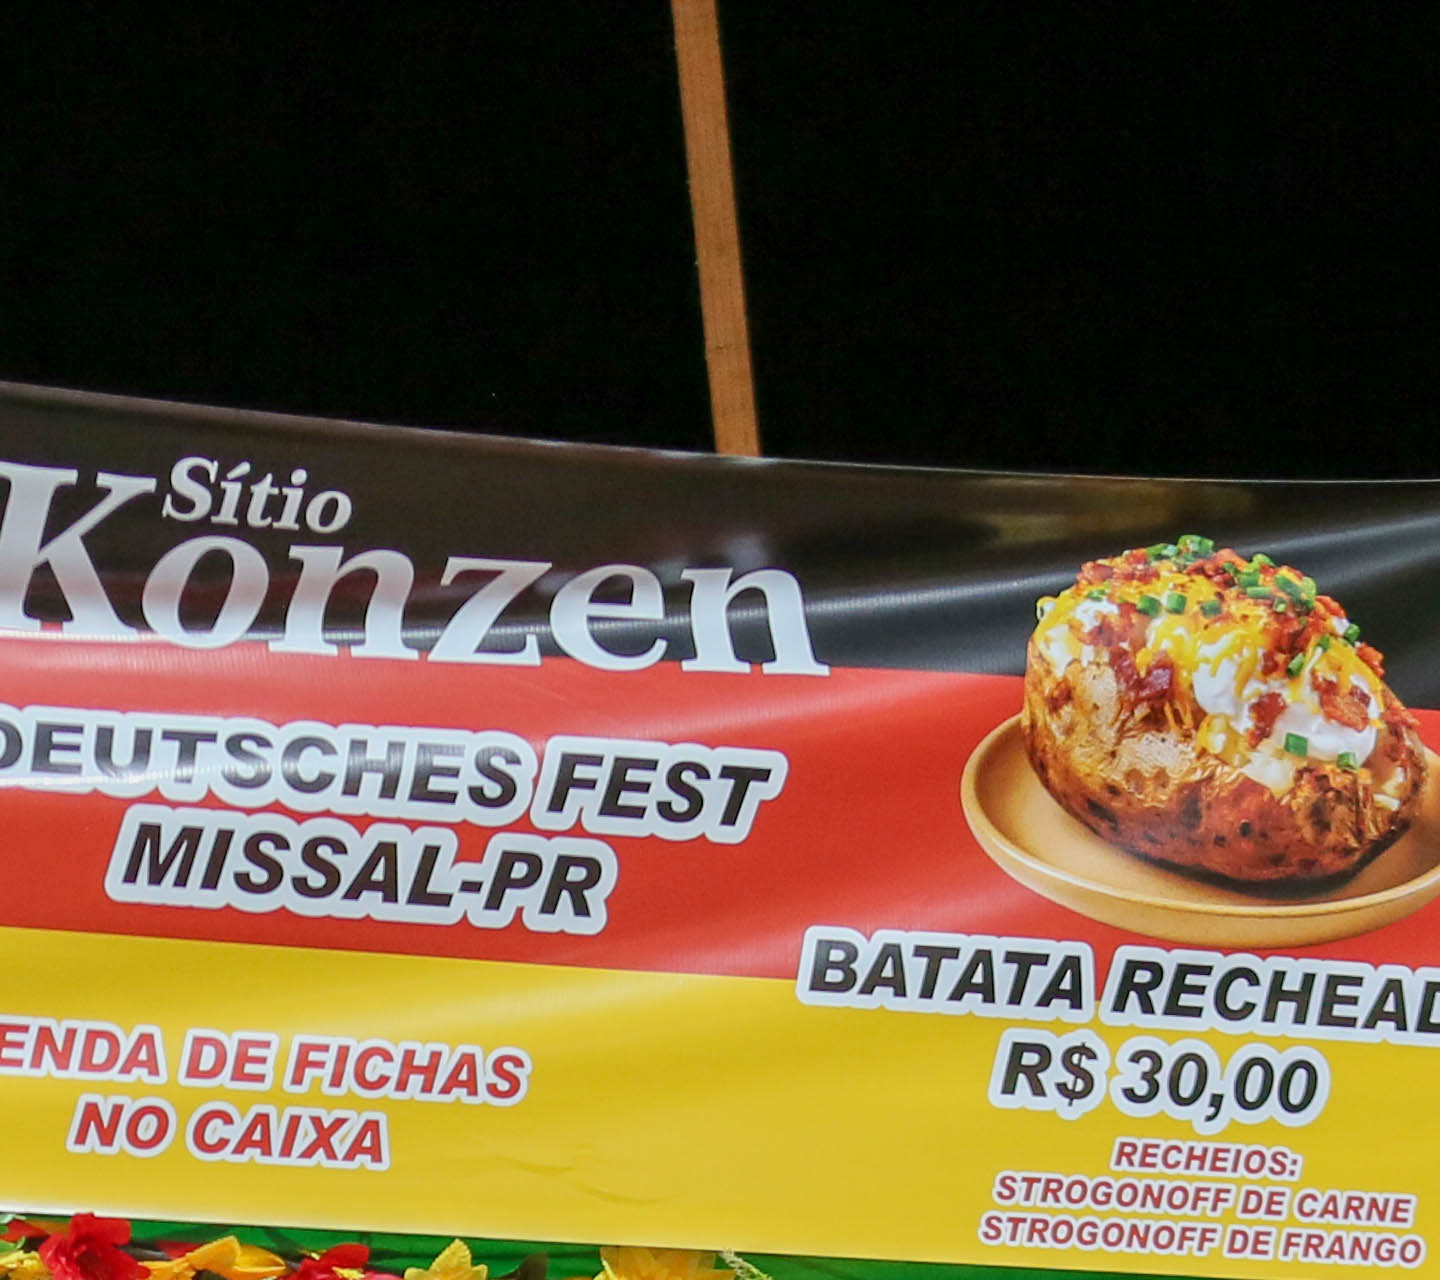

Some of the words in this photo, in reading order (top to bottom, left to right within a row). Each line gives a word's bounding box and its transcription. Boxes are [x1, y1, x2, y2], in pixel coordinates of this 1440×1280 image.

[162, 456, 353, 534] Sítio
[546, 753, 770, 829] FEST
[124, 823, 605, 917] MISSAL-PR
[808, 939, 1084, 1011] BATATA
[184, 1036, 272, 1084] DE
[290, 1042, 524, 1099] FICHAS
[1001, 1042, 1095, 1107] R$
[1121, 1049, 1319, 1122] 30,00
[74, 1102, 170, 1151] NO
[192, 1109, 384, 1163] CAIXA
[1114, 1141, 1300, 1178] RECHEIOS:
[995, 1176, 1232, 1217] STROGONOFF
[1239, 1189, 1285, 1216] DE
[1297, 1192, 1413, 1225] CARNE
[980, 1216, 1218, 1254] STROGONOFF
[1226, 1230, 1274, 1256] DE
[1280, 1233, 1423, 1265] FRANGO
